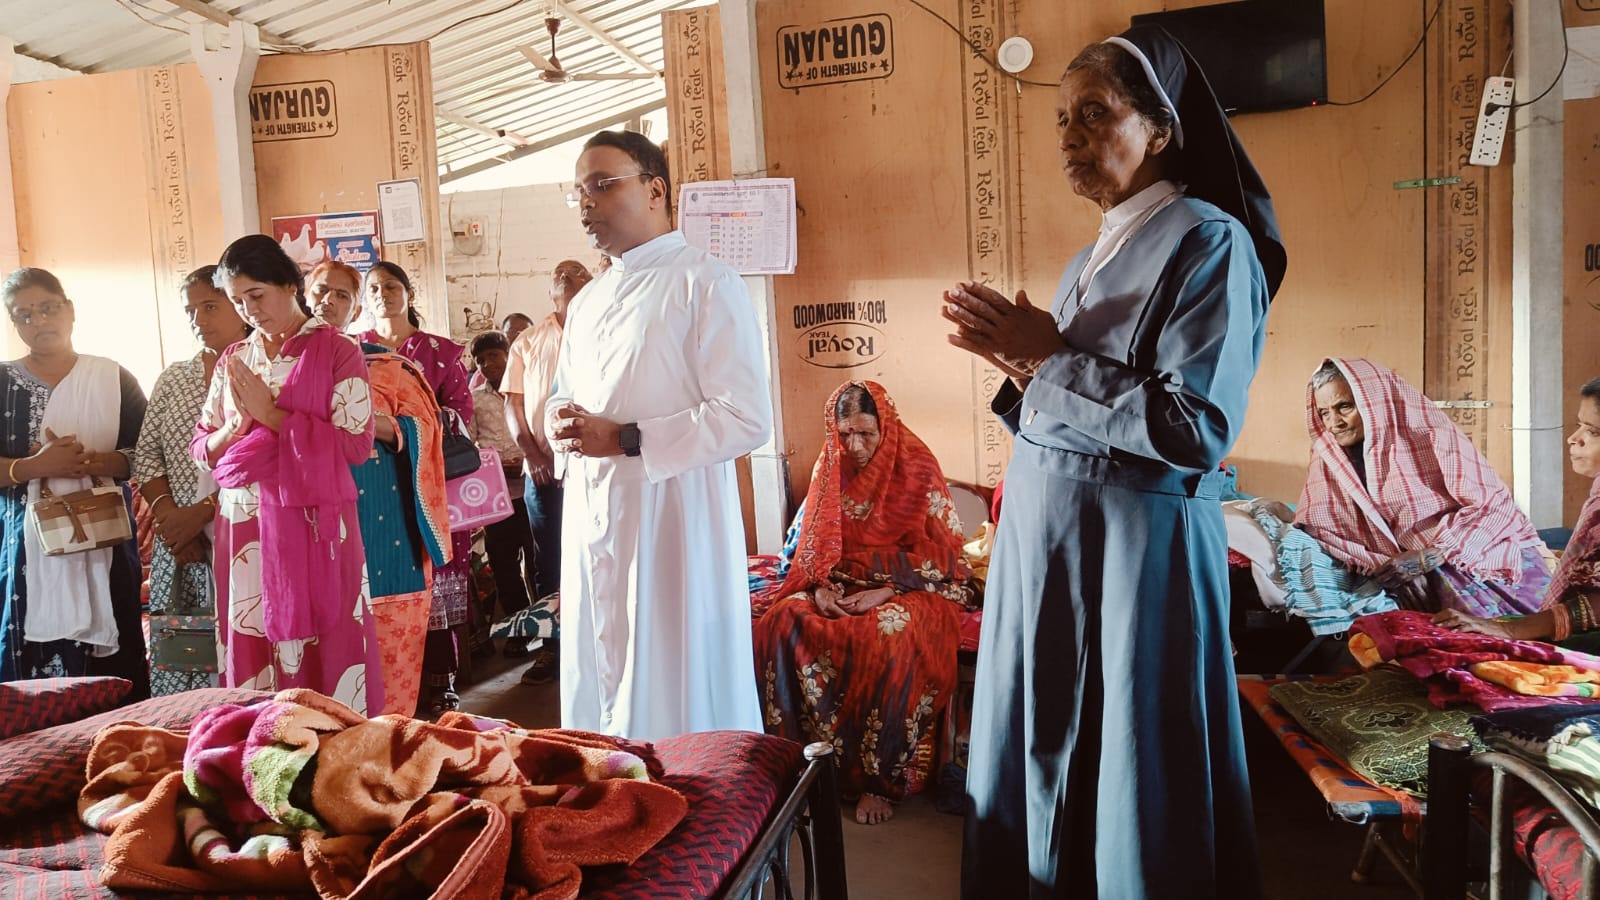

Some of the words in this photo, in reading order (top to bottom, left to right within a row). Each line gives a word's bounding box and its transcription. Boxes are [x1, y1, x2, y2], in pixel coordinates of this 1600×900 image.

[685, 11, 700, 59] Royal
[784, 21, 885, 65] GURJAN
[1458, 6, 1476, 62] Royal
[806, 67, 818, 80] OF
[820, 61, 867, 78] STRENGTH
[397, 91, 411, 136] Royal
[972, 69, 989, 120] Royal
[160, 99, 175, 142] Royal
[265, 125, 275, 136] OF
[277, 121, 316, 135] STRENGTH
[691, 105, 706, 154] Royal
[168, 184, 183, 225] Royal
[976, 169, 992, 220] Royal
[1458, 225, 1477, 276] Royal
[793, 302, 855, 329] HARDWOOD
[857, 300, 887, 324] 100%
[808, 334, 874, 359] Royal
[1457, 328, 1476, 381] Royal
